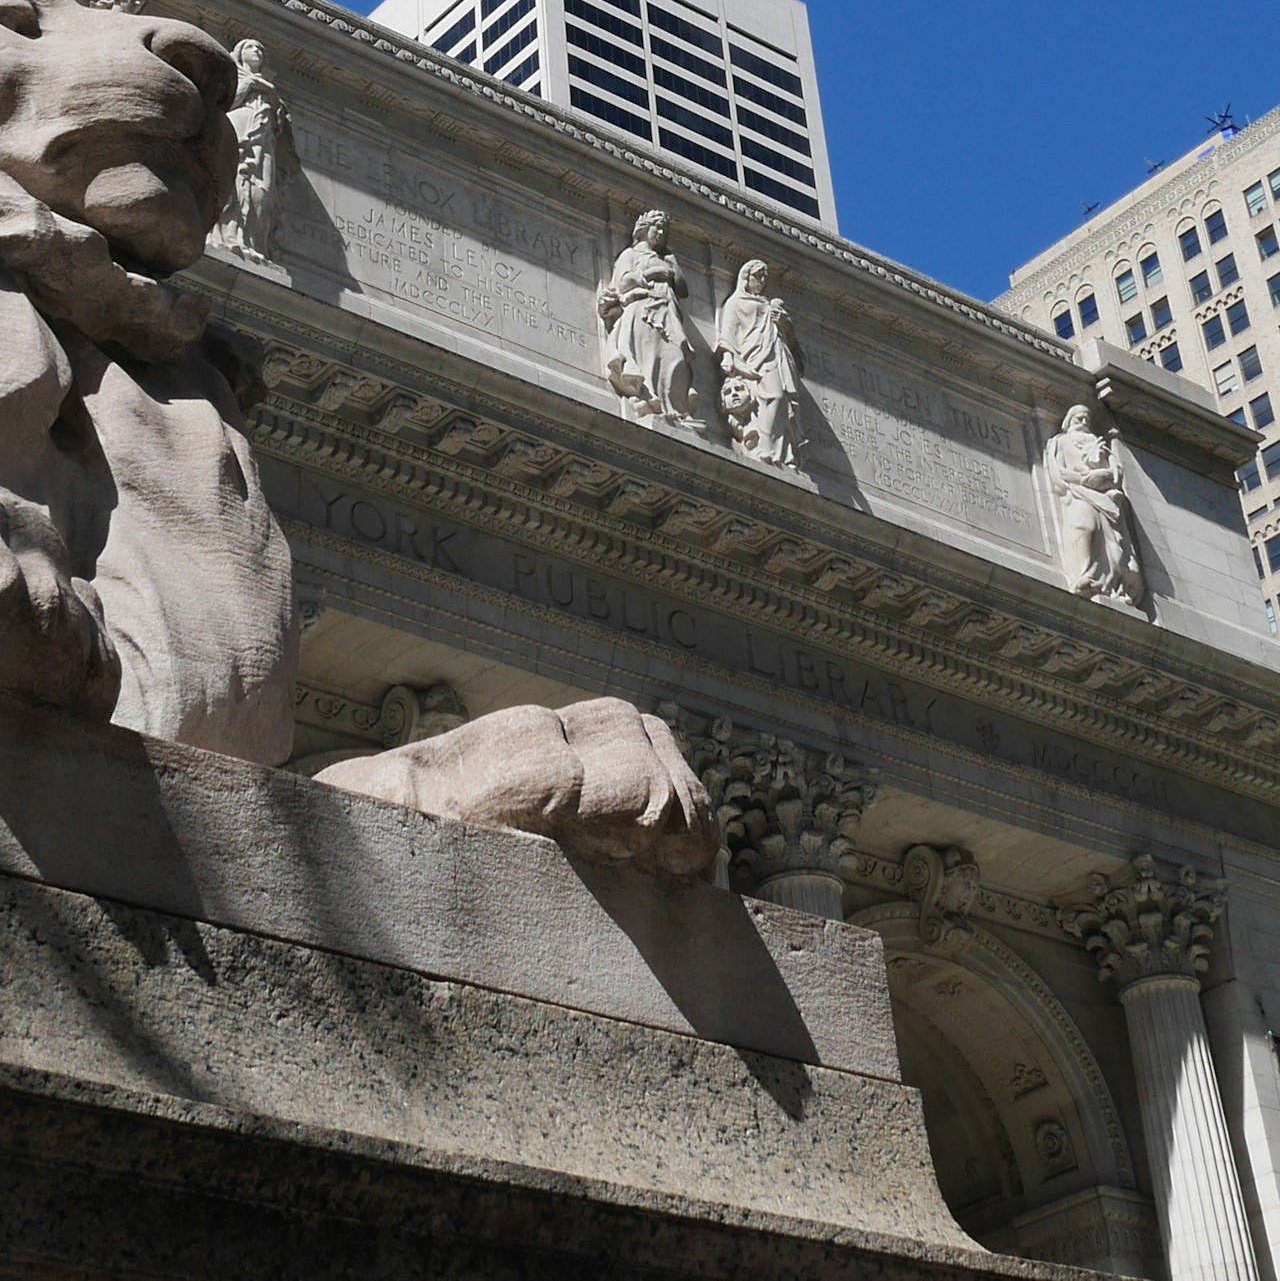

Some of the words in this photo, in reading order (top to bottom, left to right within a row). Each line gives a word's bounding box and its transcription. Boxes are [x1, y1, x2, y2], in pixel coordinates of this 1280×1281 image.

[297, 126, 352, 170] THE
[367, 156, 456, 214] LENOX
[471, 200, 580, 265] LIBRARY
[384, 199, 464, 240] FOUNDED
[334, 214, 429, 265] DEDICATED
[439, 257, 464, 279] TO
[362, 207, 433, 250] JAMES
[451, 241, 522, 283] LENOX
[415, 269, 449, 292] AND
[460, 284, 493, 311] THE
[502, 302, 538, 329] FINE
[546, 322, 588, 350] ARTS
[821, 396, 885, 437] SAMUEL
[948, 448, 1002, 490] TILDEN
[851, 362, 932, 417] TILDEN
[945, 404, 1014, 450] TRUST
[840, 423, 879, 451] SERVE
[886, 441, 912, 464] THE
[919, 455, 989, 497] INTERESTS
[993, 486, 1009, 502] OF
[864, 451, 891, 472] AND
[313, 483, 472, 580] YORK
[512, 552, 699, 650] PUBLIC
[745, 624, 937, 733] LIBRARY
